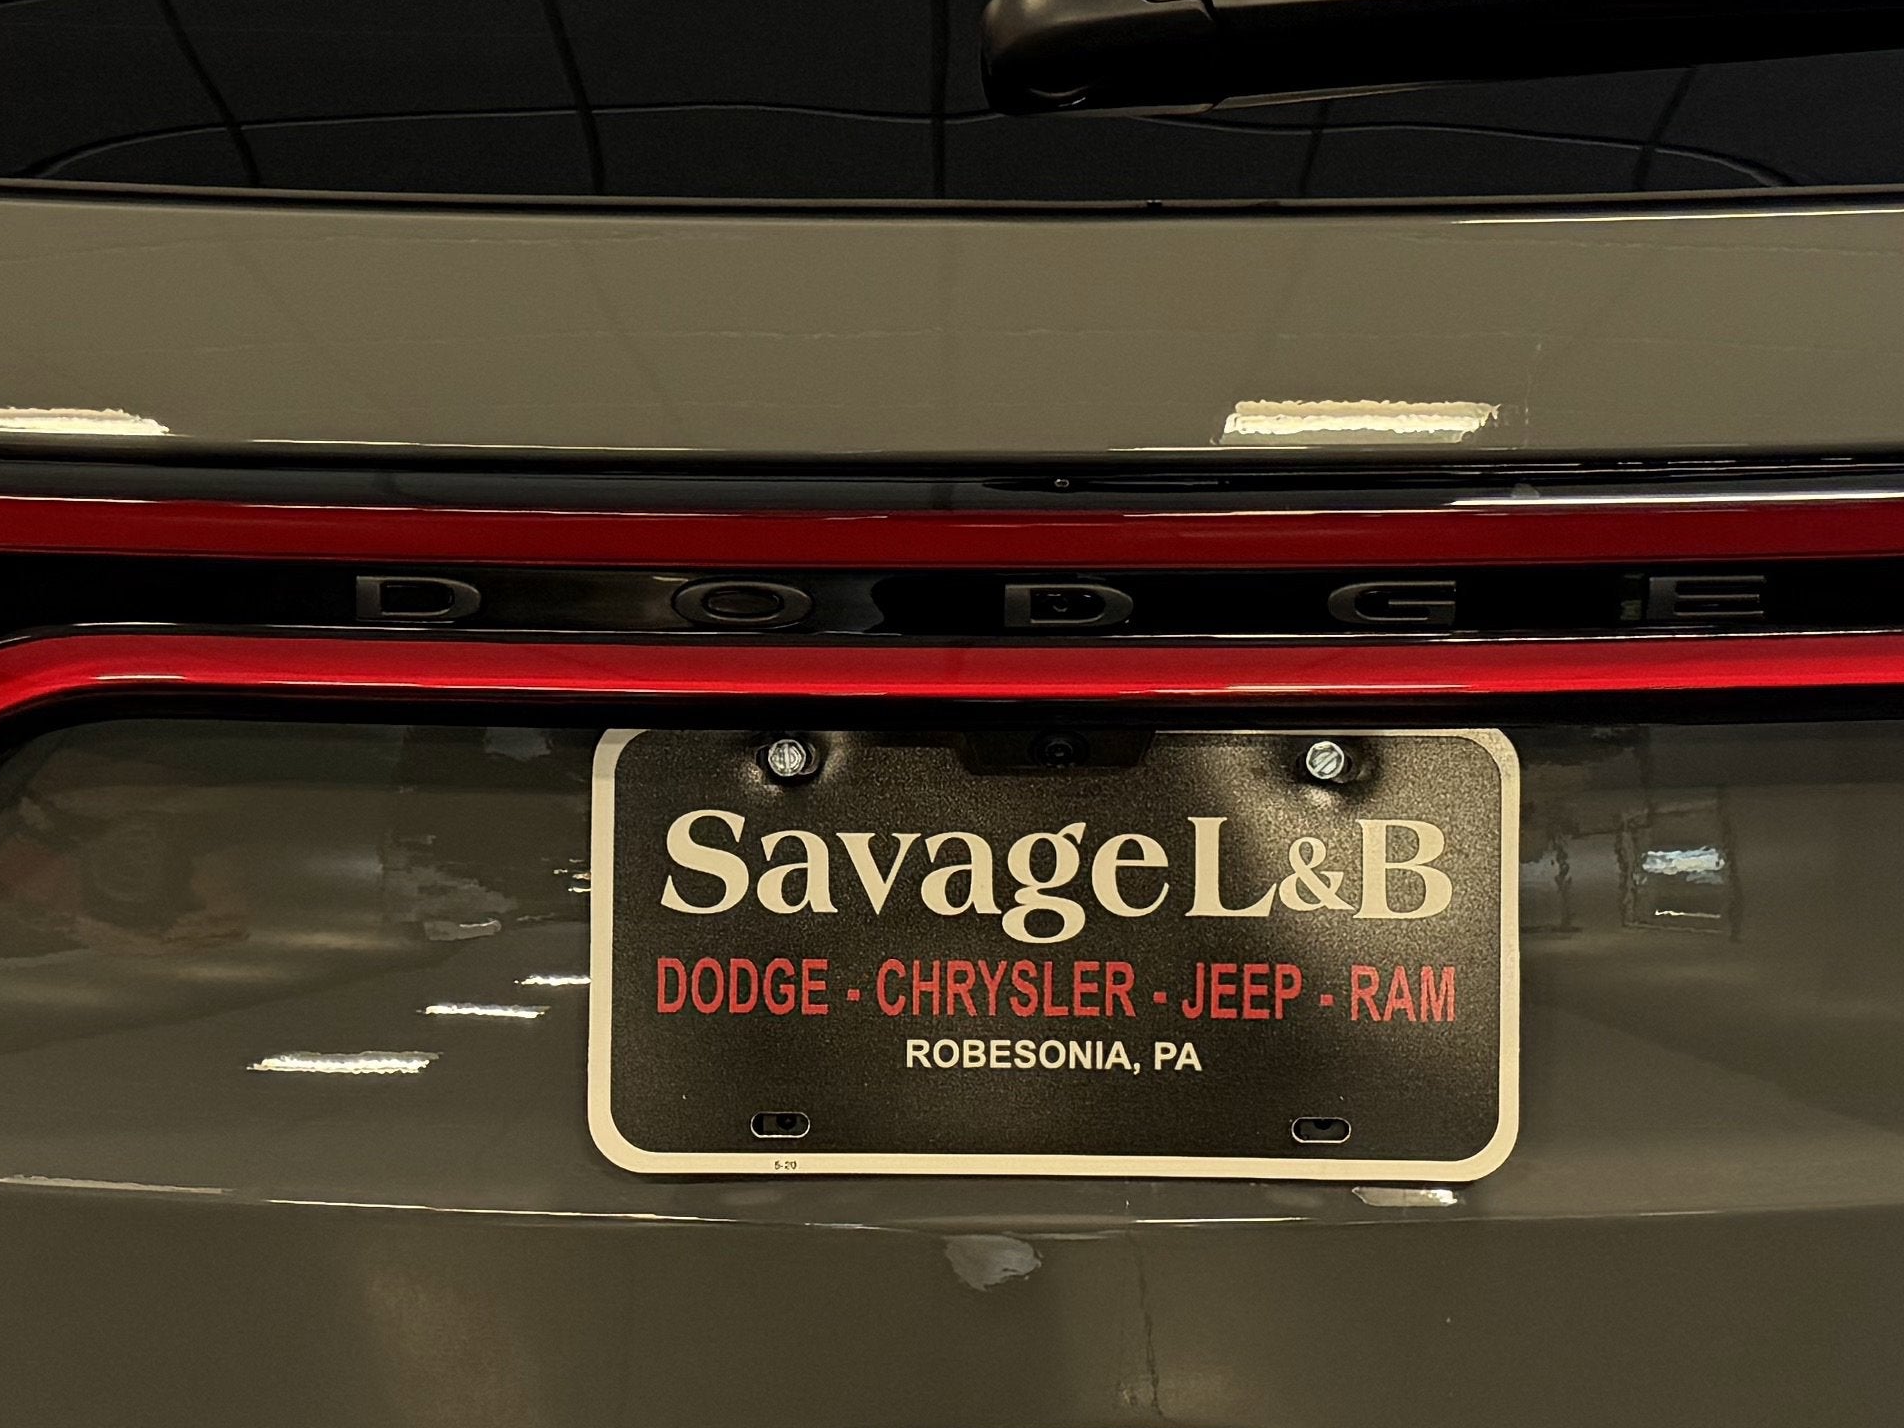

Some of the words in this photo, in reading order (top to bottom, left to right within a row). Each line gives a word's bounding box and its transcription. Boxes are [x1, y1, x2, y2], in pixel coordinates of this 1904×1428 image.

[356, 575, 1764, 627] DODGE
[657, 957, 829, 1016] DODGE
[876, 958, 1136, 1018] CHRYSLER
[1182, 962, 1303, 1021] JEEP
[1351, 964, 1457, 1023] RAM
[906, 1038, 1141, 1075] ROBESONIA,
[1154, 1040, 1202, 1072] PA
